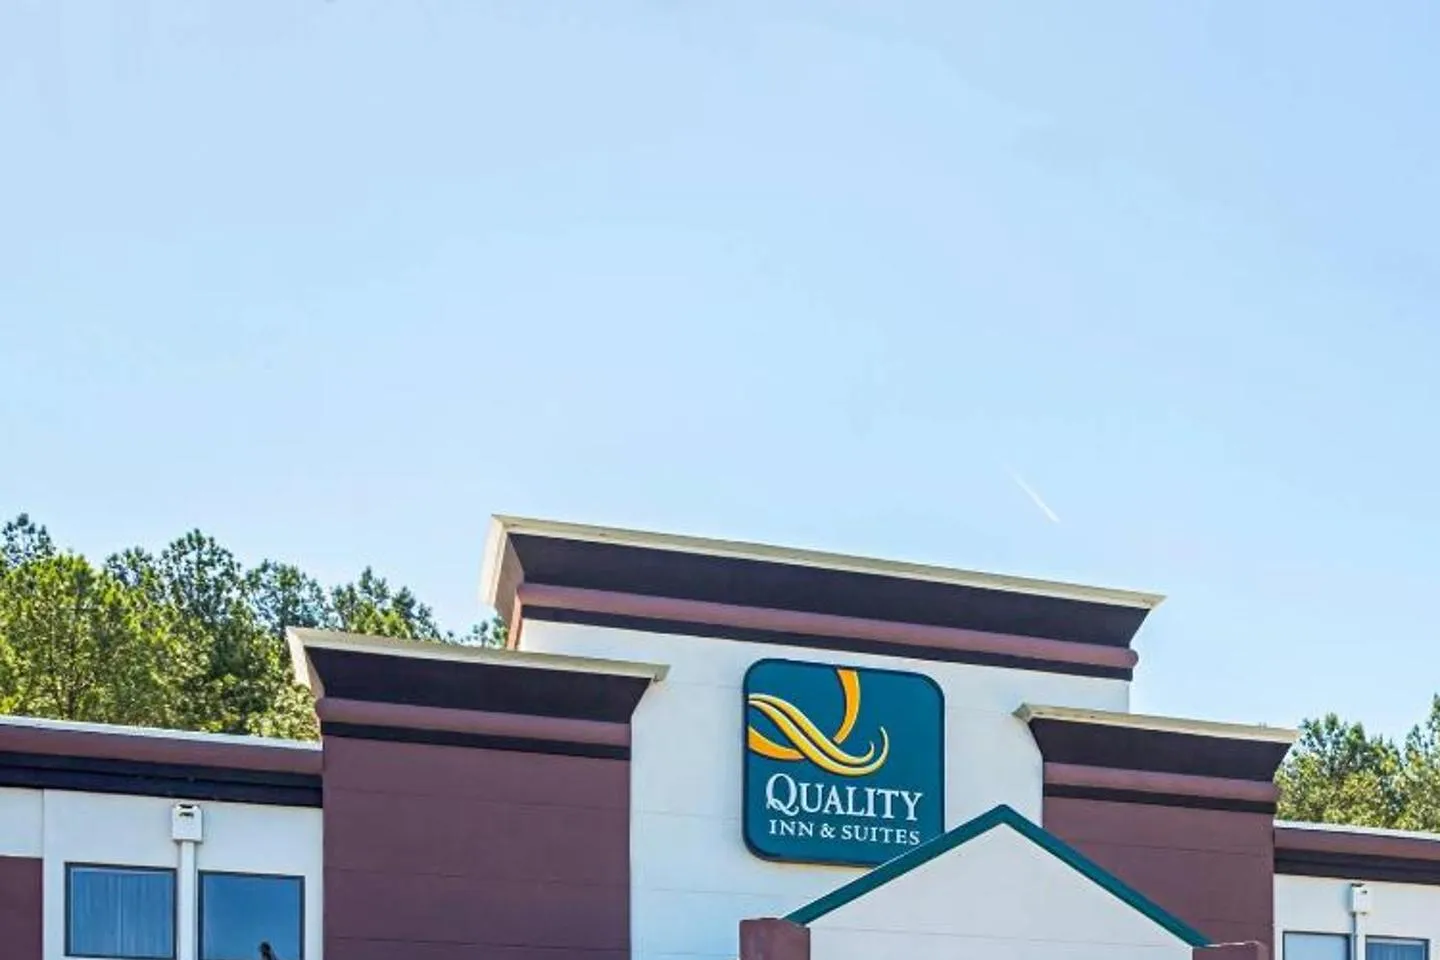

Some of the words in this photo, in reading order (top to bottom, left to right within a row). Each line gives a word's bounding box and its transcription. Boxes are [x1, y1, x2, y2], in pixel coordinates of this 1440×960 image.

[766, 773, 923, 821] QUALITY
[769, 819, 815, 837] INN
[820, 823, 836, 838] &
[841, 825, 921, 845] SUITES
